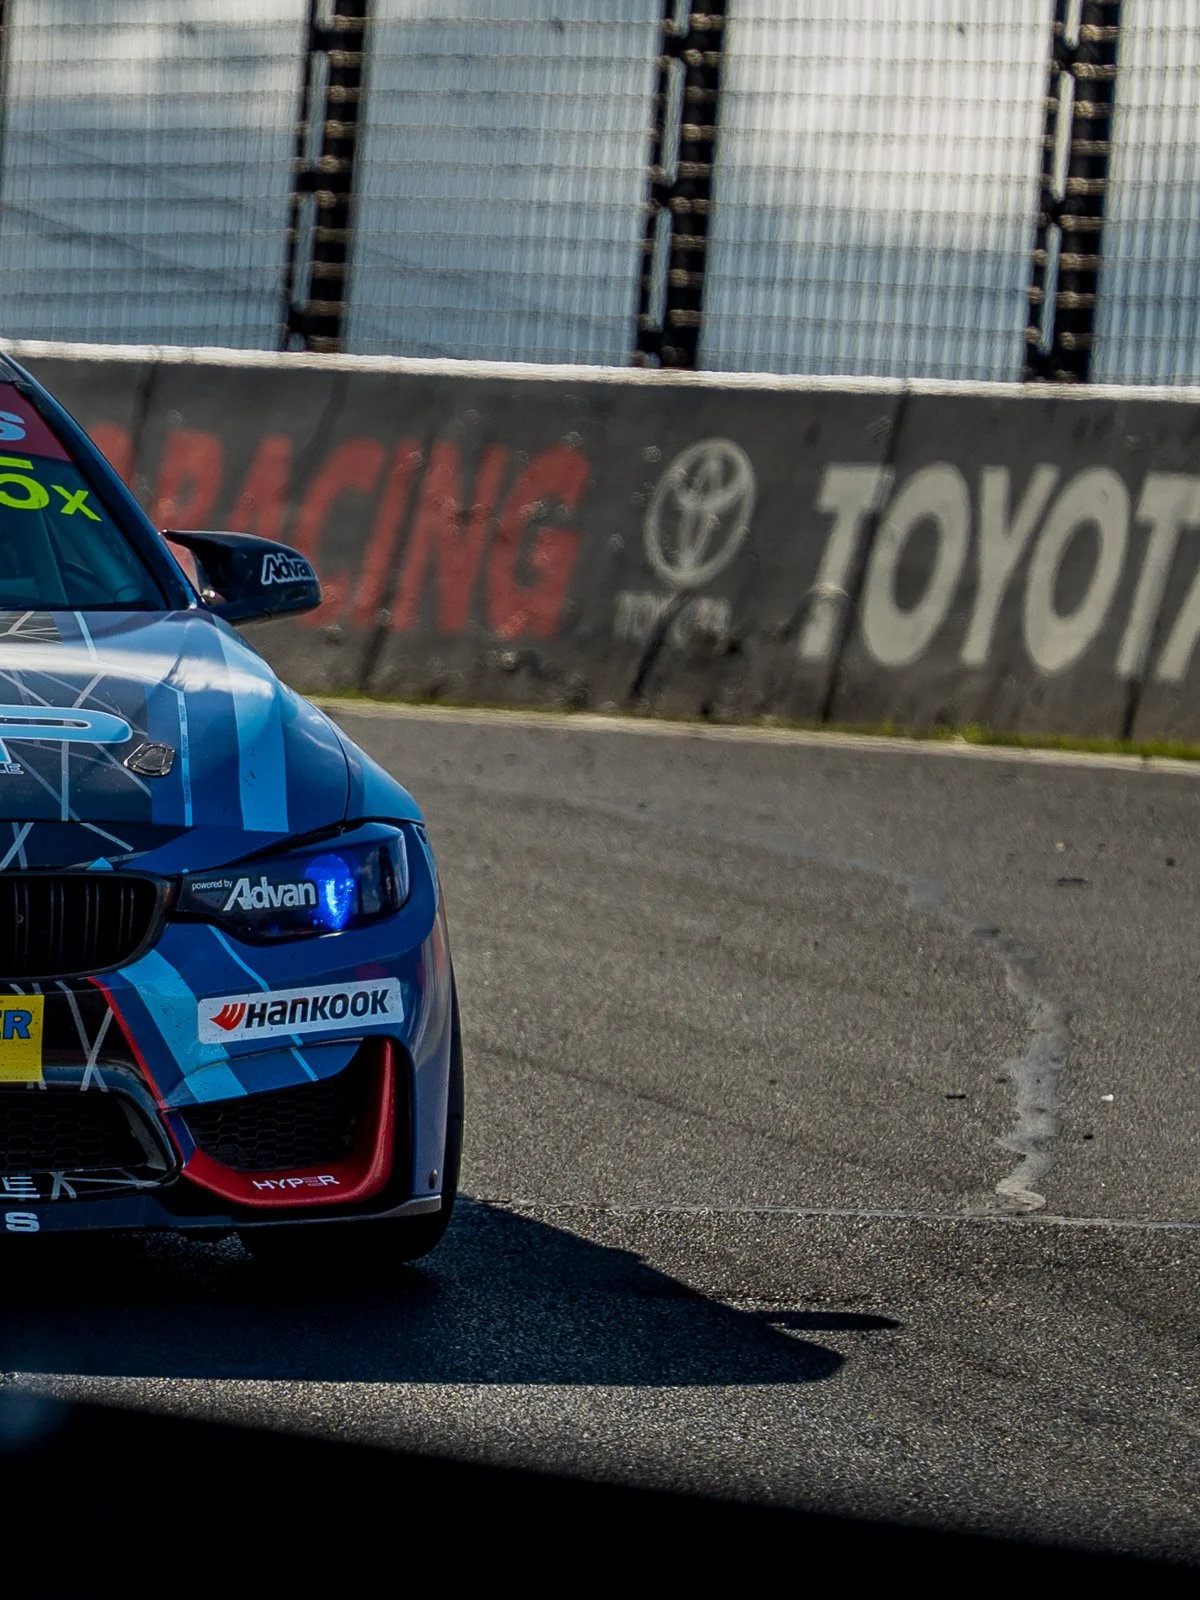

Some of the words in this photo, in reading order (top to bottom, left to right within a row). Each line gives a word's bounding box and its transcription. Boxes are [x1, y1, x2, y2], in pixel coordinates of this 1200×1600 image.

[261, 553, 318, 585] Adva
[191, 879, 223, 891] powered
[222, 876, 317, 911] Advan
[223, 879, 233, 889] by
